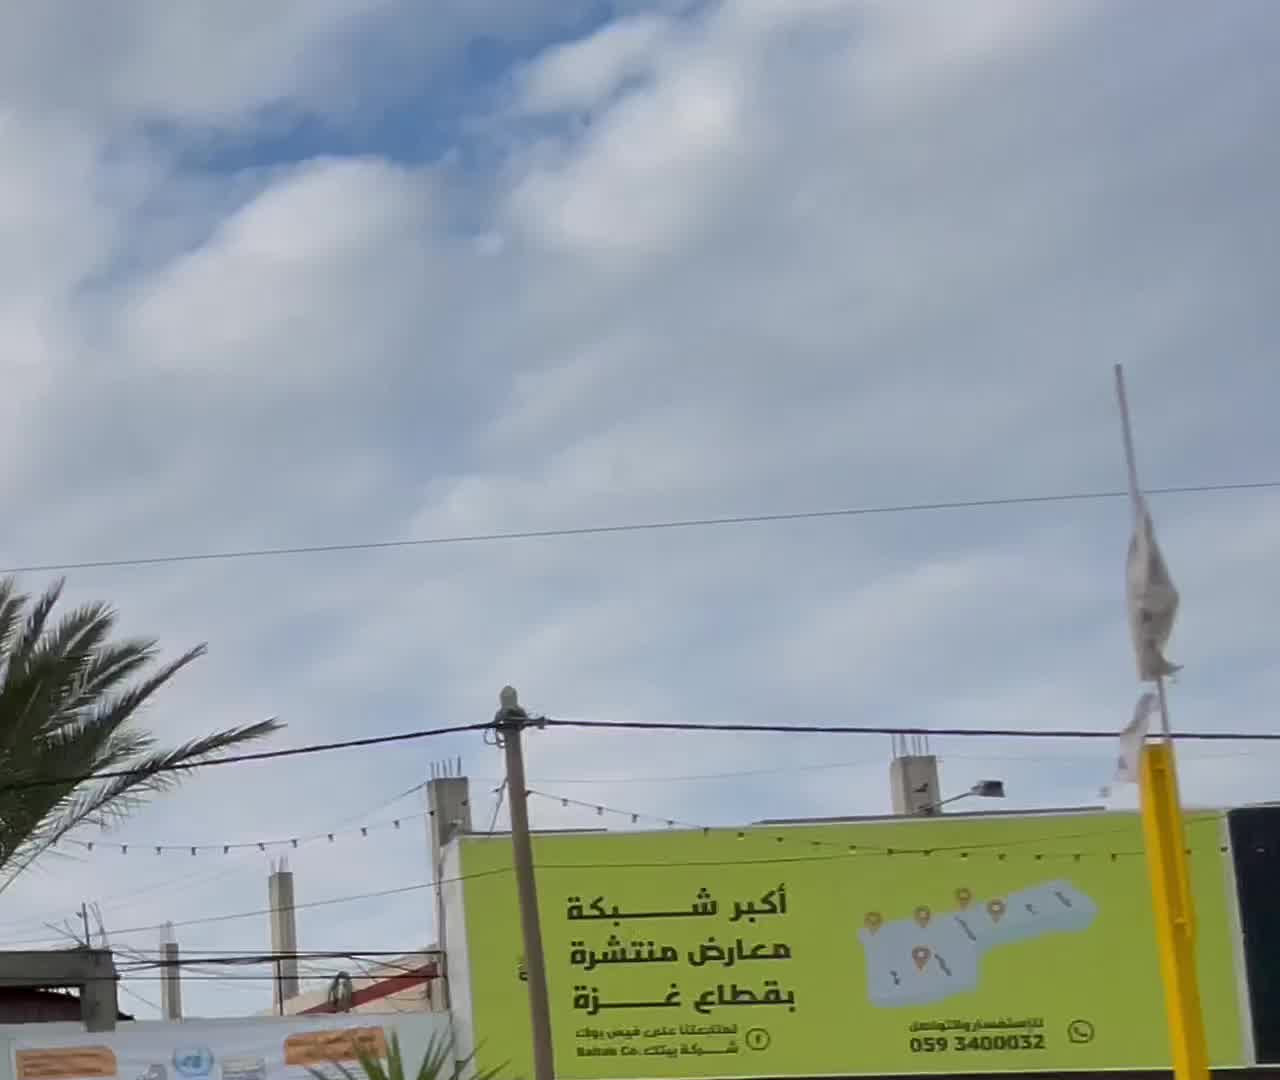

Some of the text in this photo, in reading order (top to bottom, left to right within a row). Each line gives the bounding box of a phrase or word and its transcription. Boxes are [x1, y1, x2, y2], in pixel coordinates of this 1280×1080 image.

[566, 883, 787, 926] أكبر شبكة
[570, 935, 793, 970] معارض منتشرة
[573, 981, 796, 1015] بقطاع غزة
[910, 1034, 1045, 1053] 059 3400032
